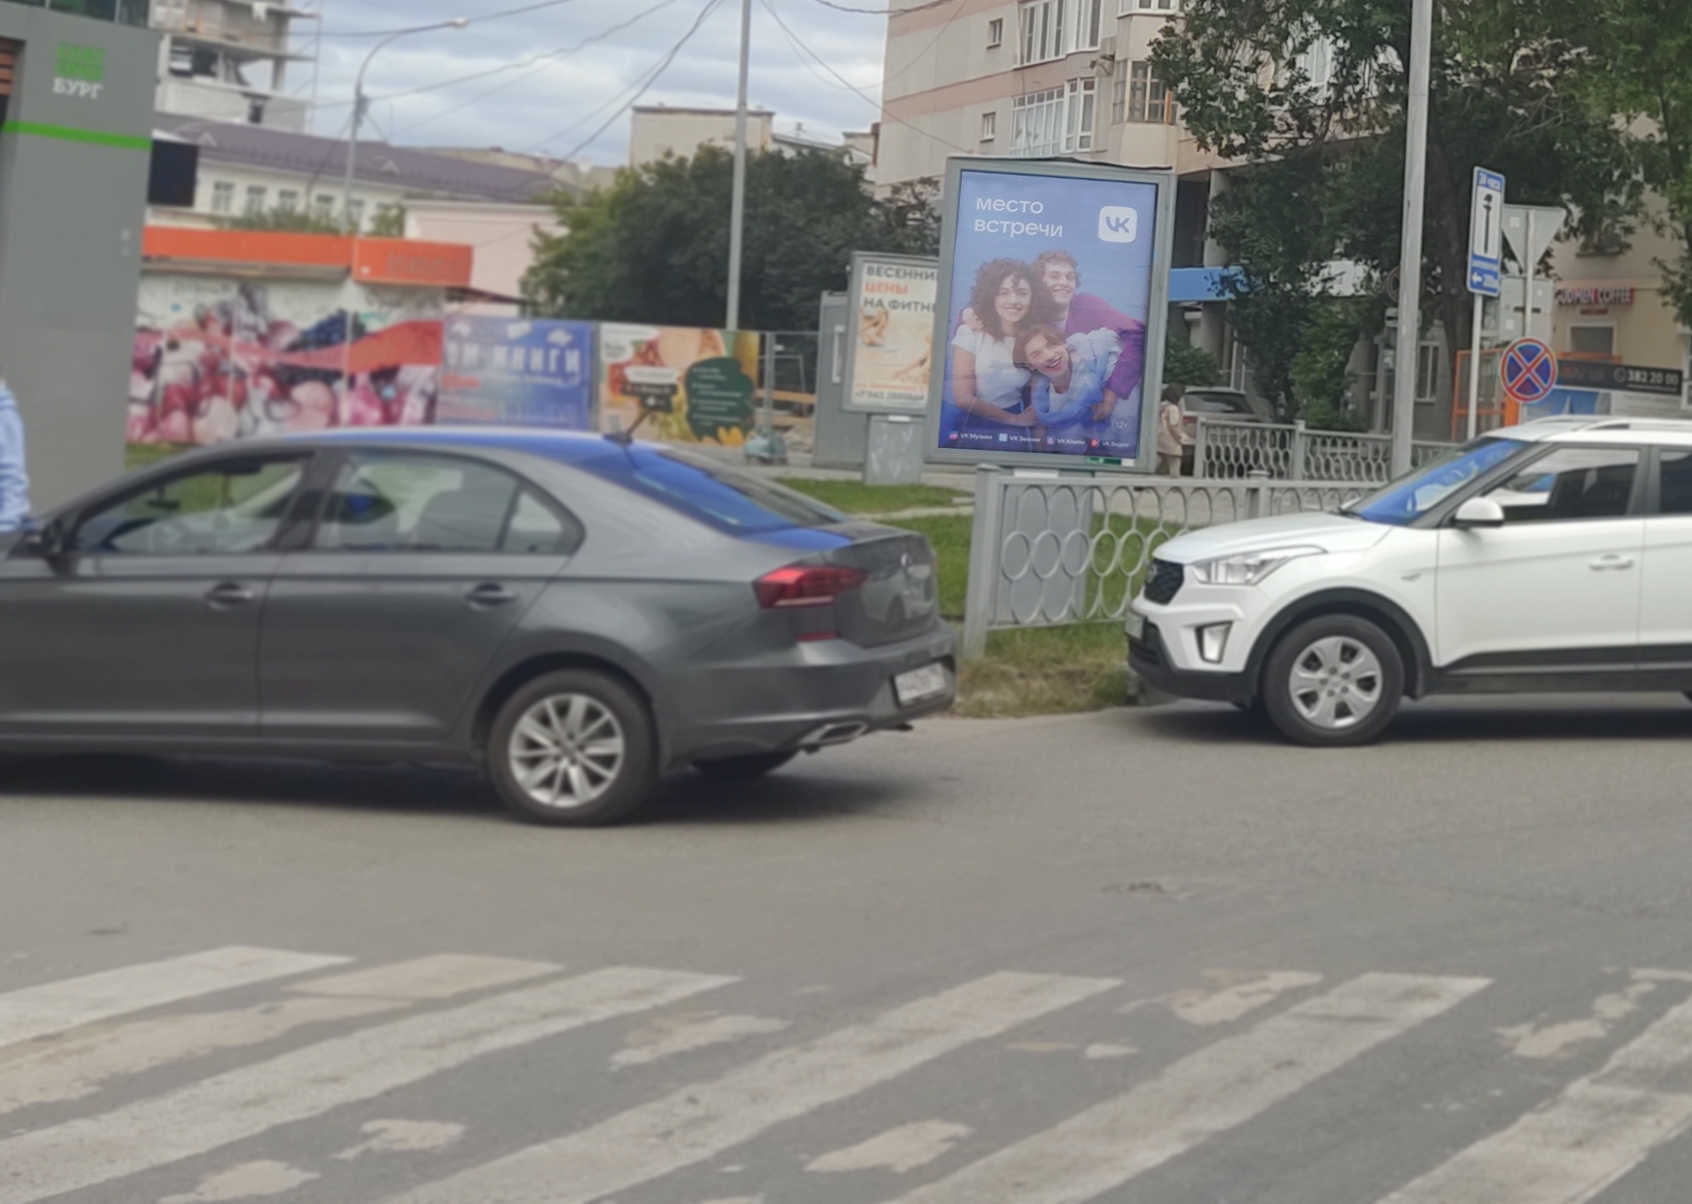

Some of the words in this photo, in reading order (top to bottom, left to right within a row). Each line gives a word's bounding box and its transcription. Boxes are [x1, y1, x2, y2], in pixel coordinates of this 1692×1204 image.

[53, 77, 104, 100] БУРГ
[976, 197, 1044, 215] место
[974, 219, 1064, 238] встречи
[1105, 215, 1131, 234] VK
[866, 265, 936, 282] ВЕСЕННИ
[865, 281, 909, 295] ЦЕНЫ
[1598, 286, 1633, 305] COFFEE
[863, 297, 885, 310] НА
[493, 345, 580, 374] КНИГИ
[1626, 369, 1649, 384] 382
[1650, 372, 1664, 385] 20
[1116, 421, 1128, 430] 12+
